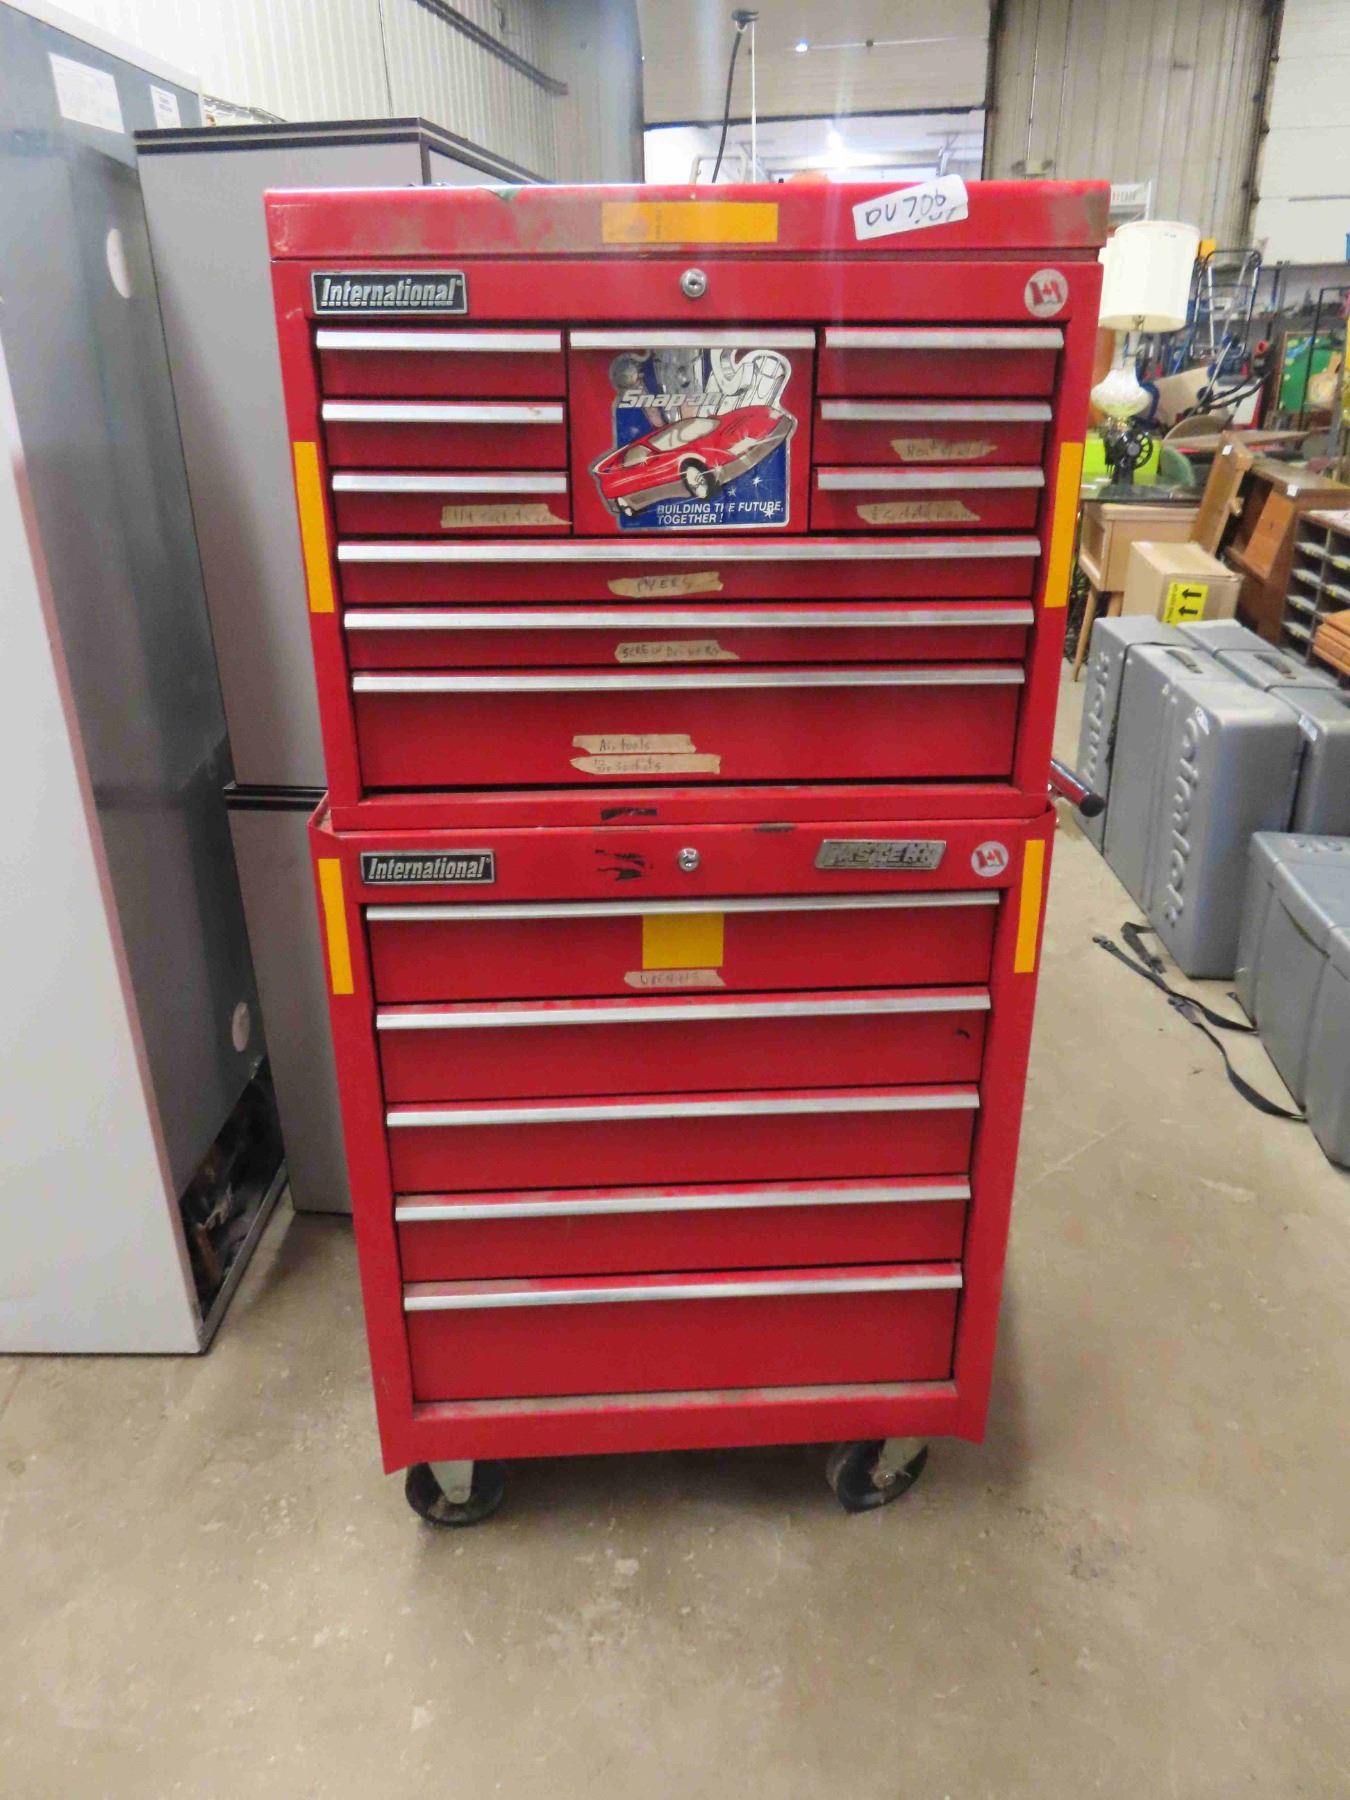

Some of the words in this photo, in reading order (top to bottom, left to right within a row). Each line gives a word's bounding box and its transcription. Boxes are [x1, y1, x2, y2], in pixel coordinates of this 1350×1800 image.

[320, 278, 457, 307] International
[656, 503, 711, 515] BUILDING
[738, 501, 784, 513] FUTURE,
[368, 857, 486, 879] International
